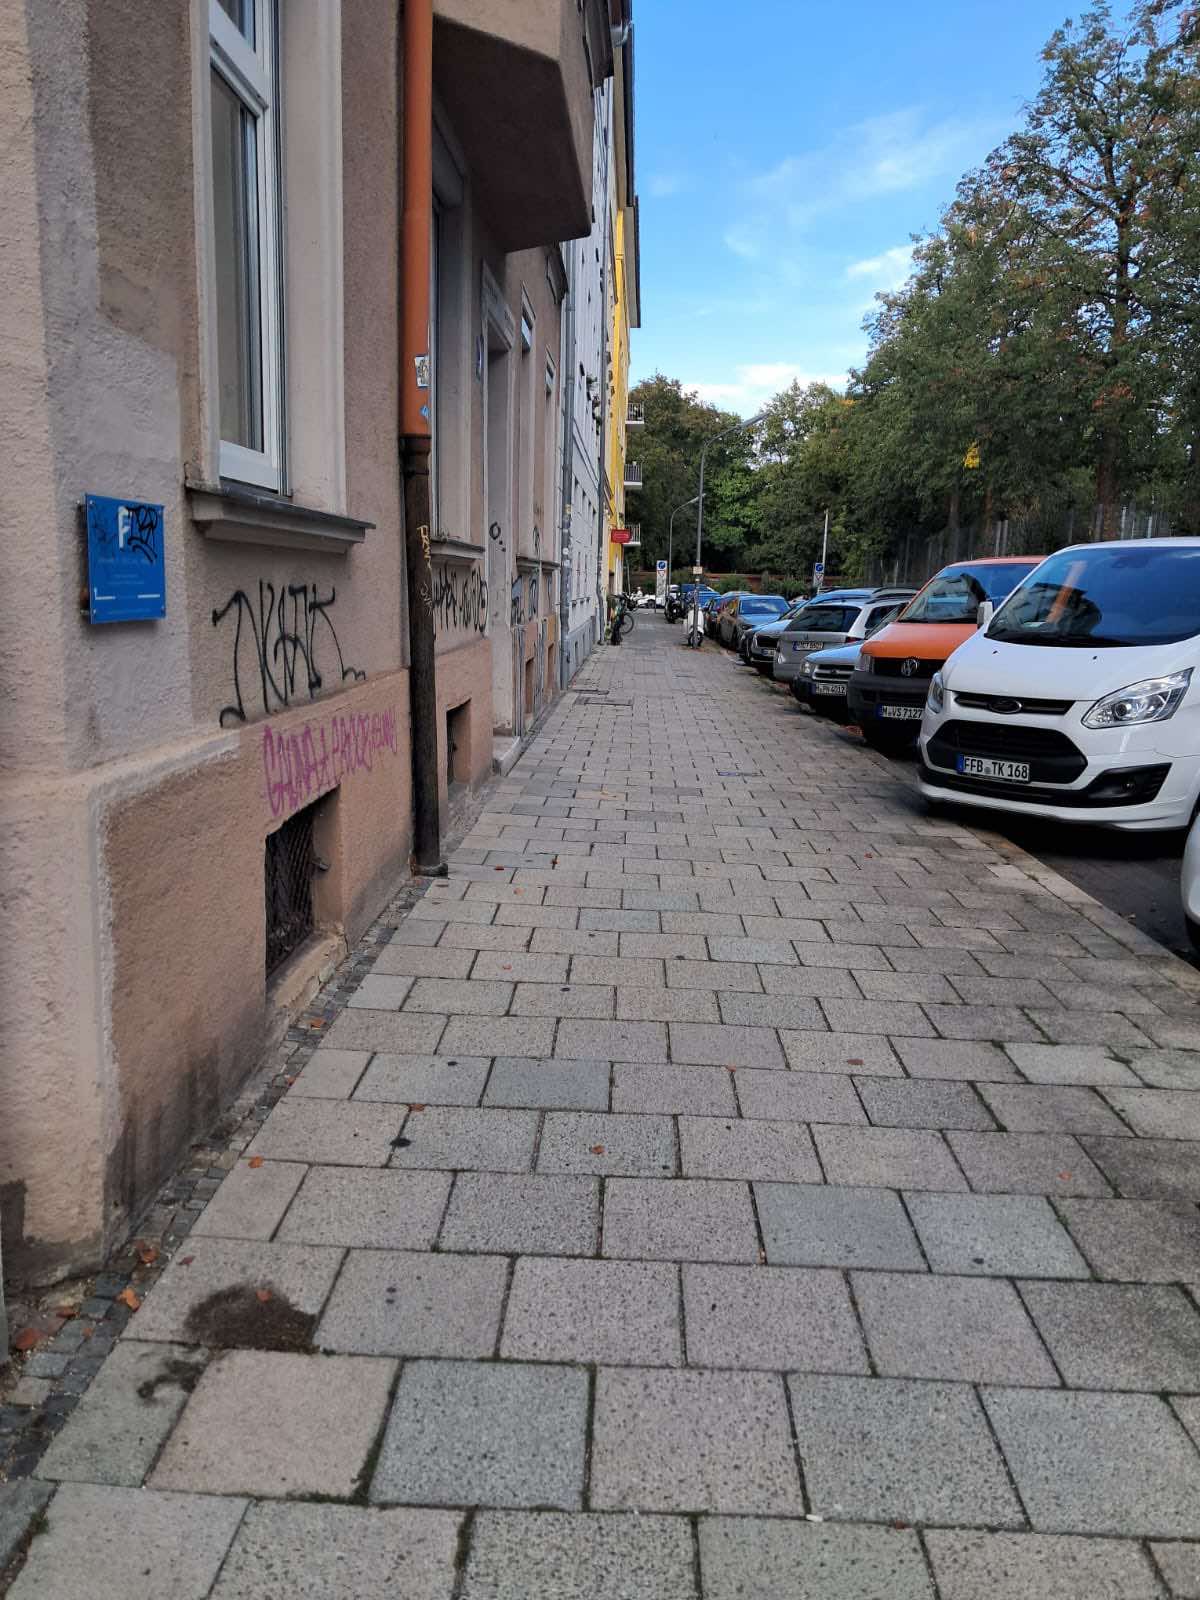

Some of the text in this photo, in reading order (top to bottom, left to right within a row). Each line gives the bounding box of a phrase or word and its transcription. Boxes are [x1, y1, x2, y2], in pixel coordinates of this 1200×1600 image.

[964, 758, 1028, 779] FFB TK 168
